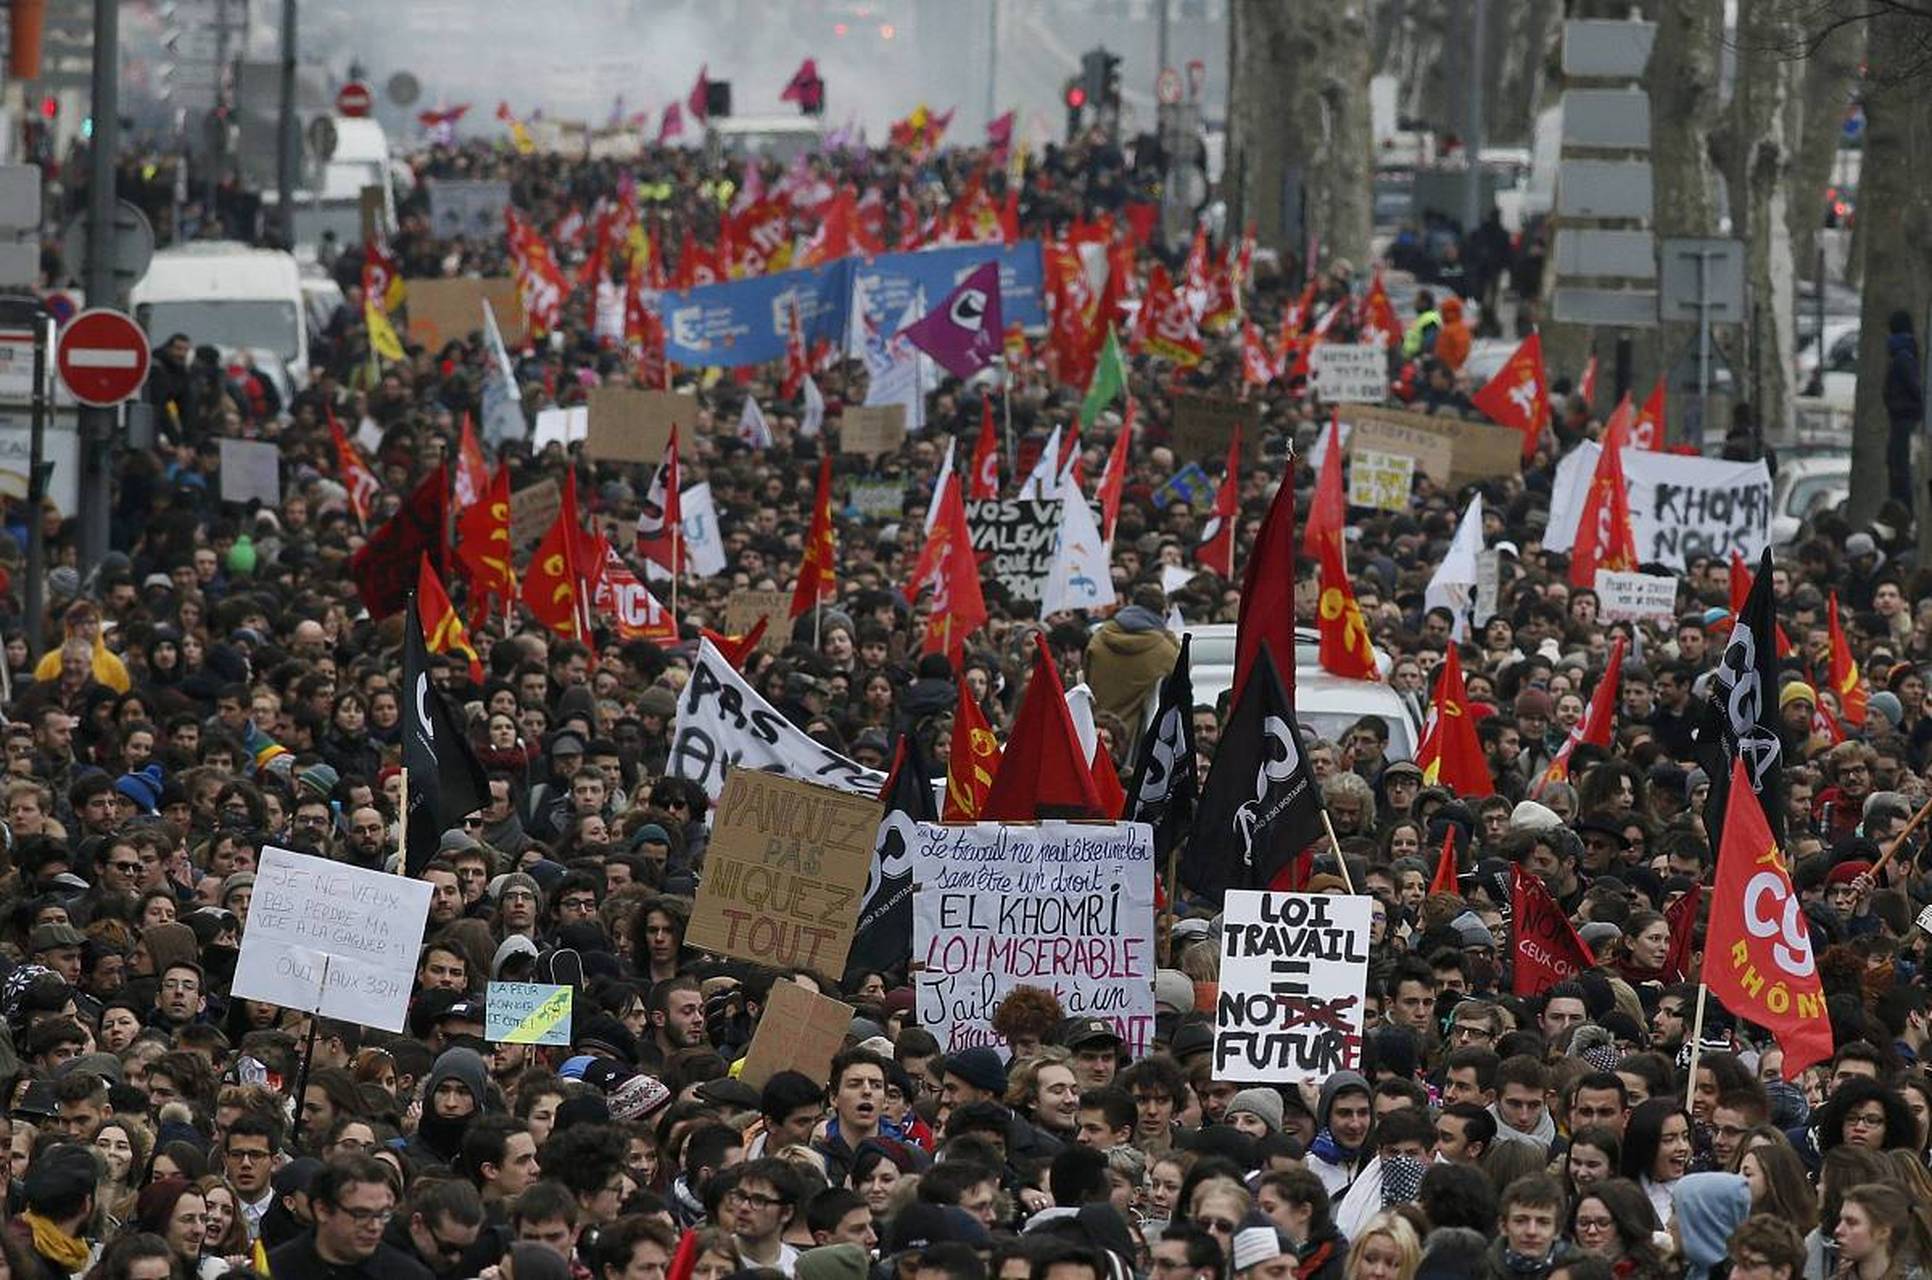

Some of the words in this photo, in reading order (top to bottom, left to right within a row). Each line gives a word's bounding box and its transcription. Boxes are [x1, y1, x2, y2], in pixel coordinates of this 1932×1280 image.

[965, 500, 1021, 522] NOS
[1653, 528, 1750, 559] NOUS
[994, 553, 1031, 574] QUE
[688, 661, 789, 745] PAS
[723, 777, 879, 854] PANIQUEZ
[763, 837, 825, 875] PAS
[953, 825, 1007, 861] travail
[1011, 842, 1034, 863] ne
[314, 875, 349, 897] NE
[709, 857, 855, 929] NIQUEZ
[1019, 868, 1046, 893] un
[257, 914, 293, 930] VIE
[263, 891, 294, 911] PAS
[304, 899, 358, 927] PERDRE
[366, 917, 389, 936] MA
[940, 893, 989, 931] EL
[1261, 893, 1333, 928] LOI
[722, 909, 836, 967] TOUT
[1224, 924, 1367, 963] TRAVAIL
[1519, 939, 1552, 967] CEUX
[276, 957, 313, 982] OUI
[329, 970, 359, 990] AUX
[926, 935, 978, 974] LOI
[986, 937, 1145, 979] MISERABLE
[1090, 986, 1132, 1010] un
